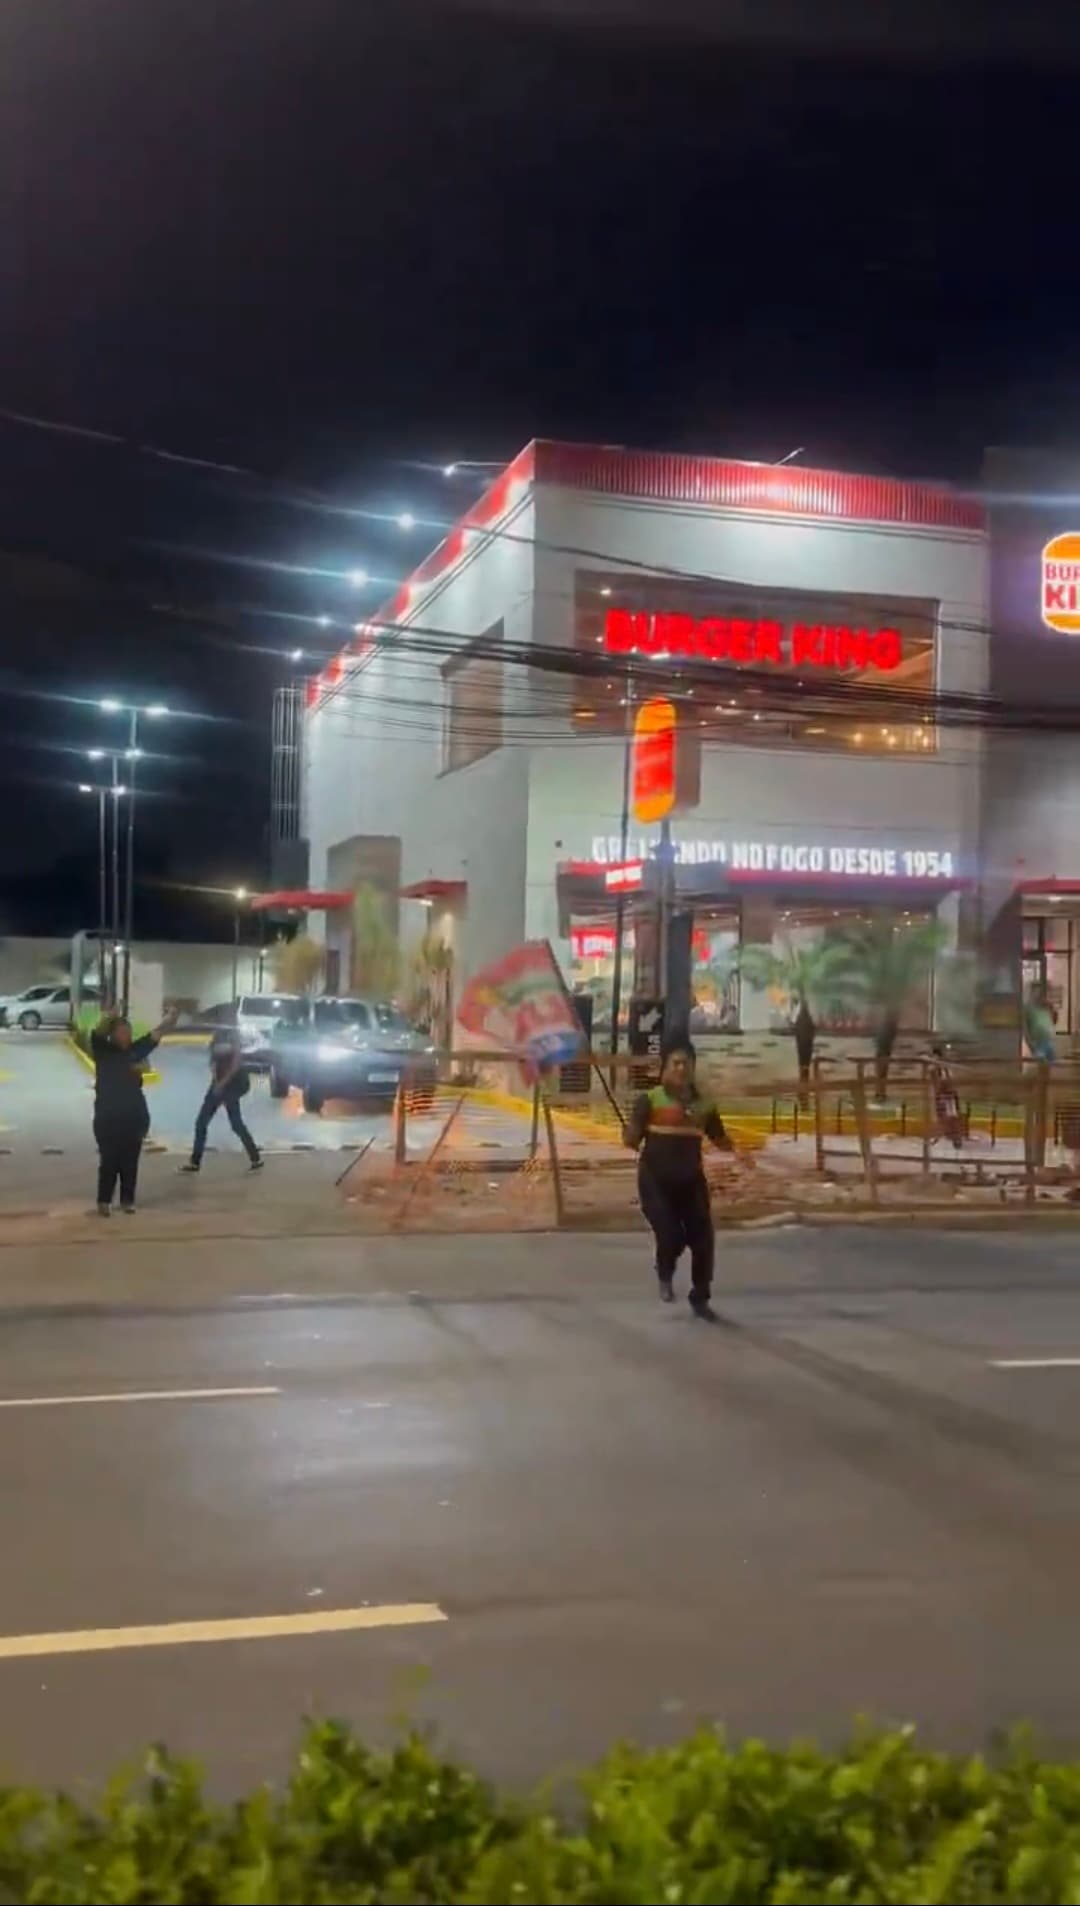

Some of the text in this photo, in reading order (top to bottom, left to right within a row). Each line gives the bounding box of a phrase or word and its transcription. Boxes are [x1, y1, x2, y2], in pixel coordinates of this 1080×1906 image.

[605, 608, 902, 671] BURGER KING
[731, 840, 763, 870] NO
[765, 843, 824, 873] FOGO
[829, 846, 897, 876] DESDE
[903, 850, 953, 878] 1954
